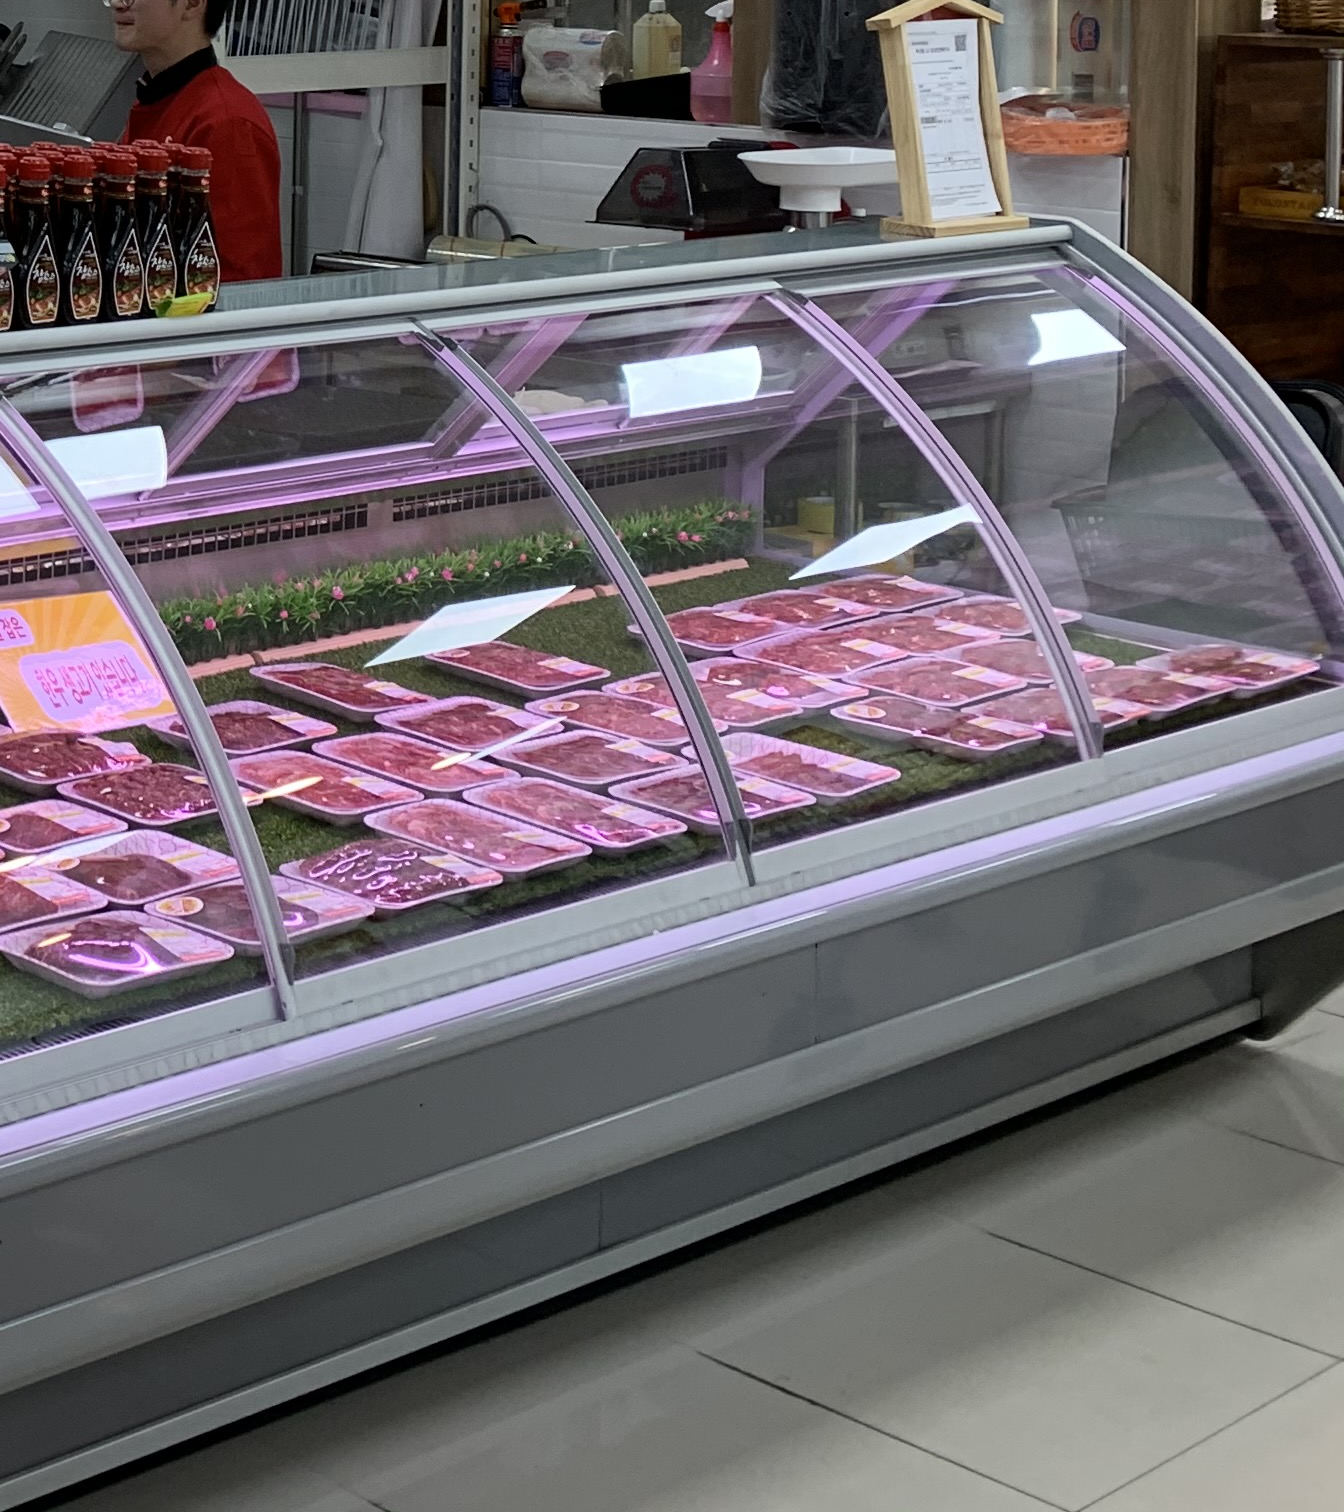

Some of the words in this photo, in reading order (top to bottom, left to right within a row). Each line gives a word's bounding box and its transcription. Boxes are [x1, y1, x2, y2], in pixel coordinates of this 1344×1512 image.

[34, 667, 70, 709] 한우
[59, 660, 104, 704] 생고기
[89, 653, 139, 700] 있습니다
